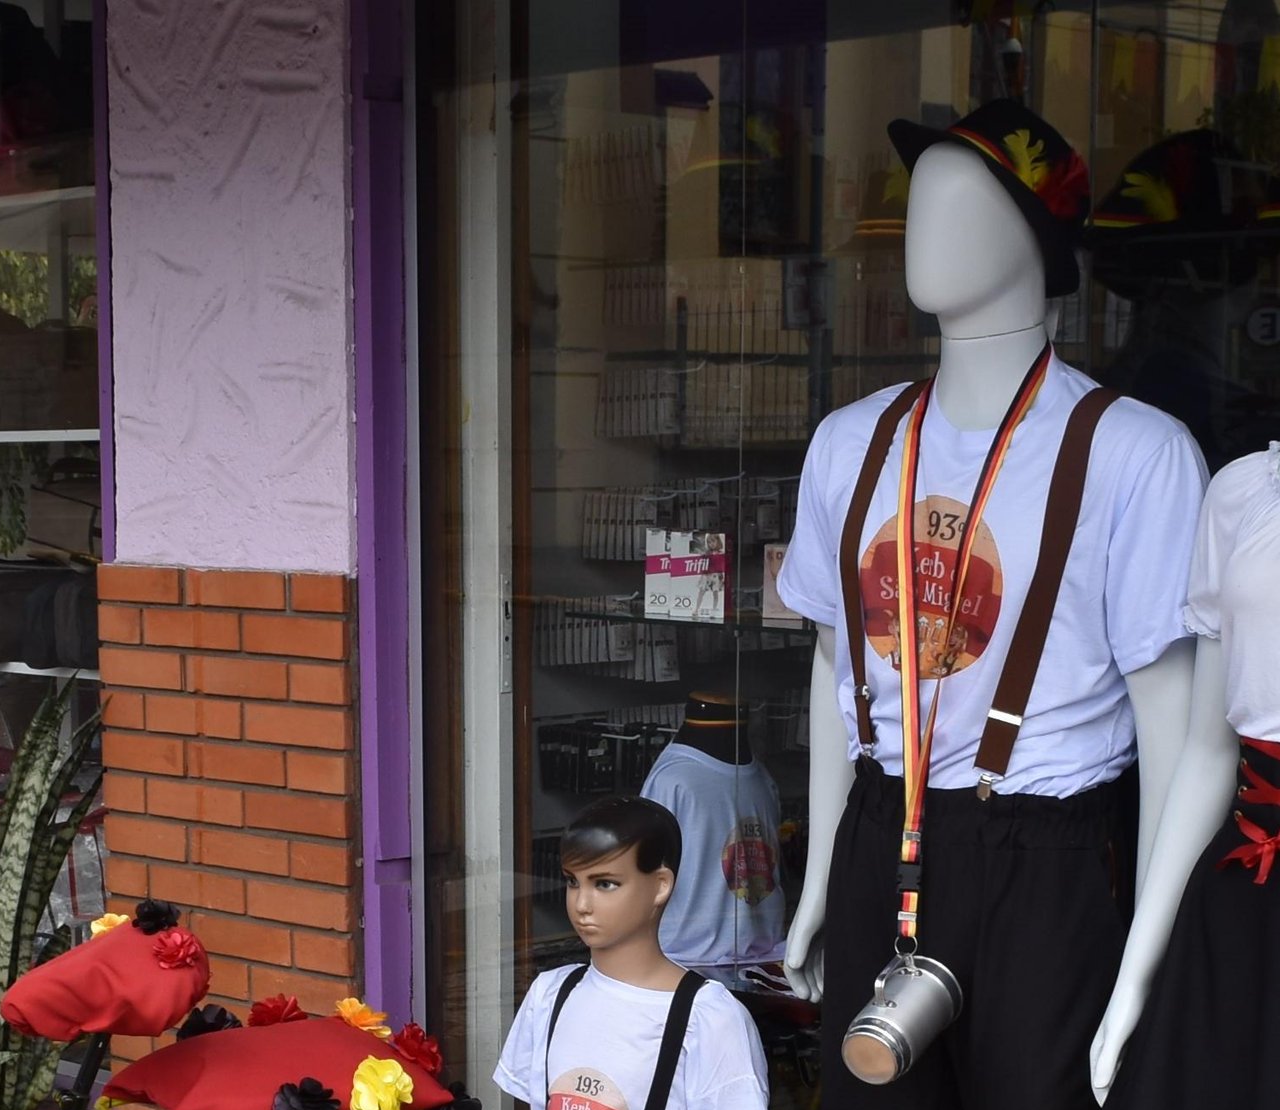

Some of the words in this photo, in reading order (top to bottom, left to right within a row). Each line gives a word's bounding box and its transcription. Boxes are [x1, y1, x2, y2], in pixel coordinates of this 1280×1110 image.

[684, 558, 709, 574] Trifil
[649, 594, 667, 605] 20
[674, 597, 692, 608] 20
[922, 580, 983, 617] Migel
